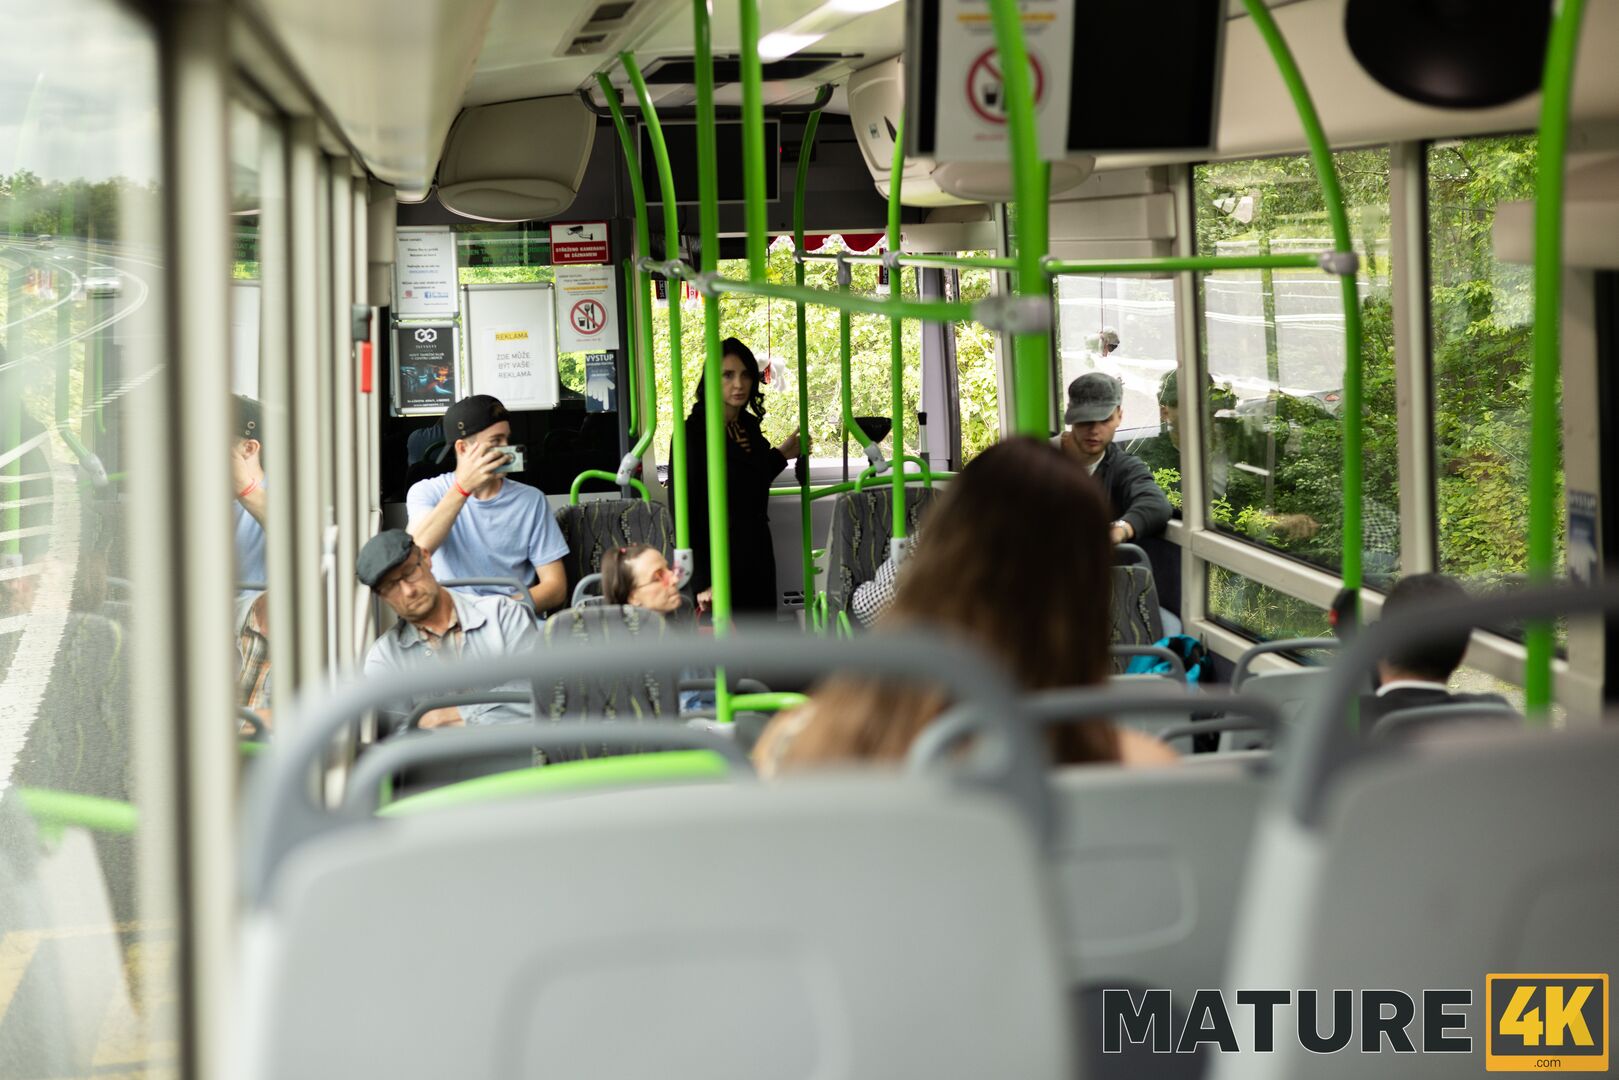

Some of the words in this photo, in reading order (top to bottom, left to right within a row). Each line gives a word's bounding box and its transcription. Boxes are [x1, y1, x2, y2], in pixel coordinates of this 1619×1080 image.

[496, 332, 529, 341] REKLAMA
[512, 351, 530, 360] MŮŽE
[498, 361, 510, 369] BÝT
[512, 360, 529, 369] VAŠE
[498, 370, 532, 378] REKLAMA
